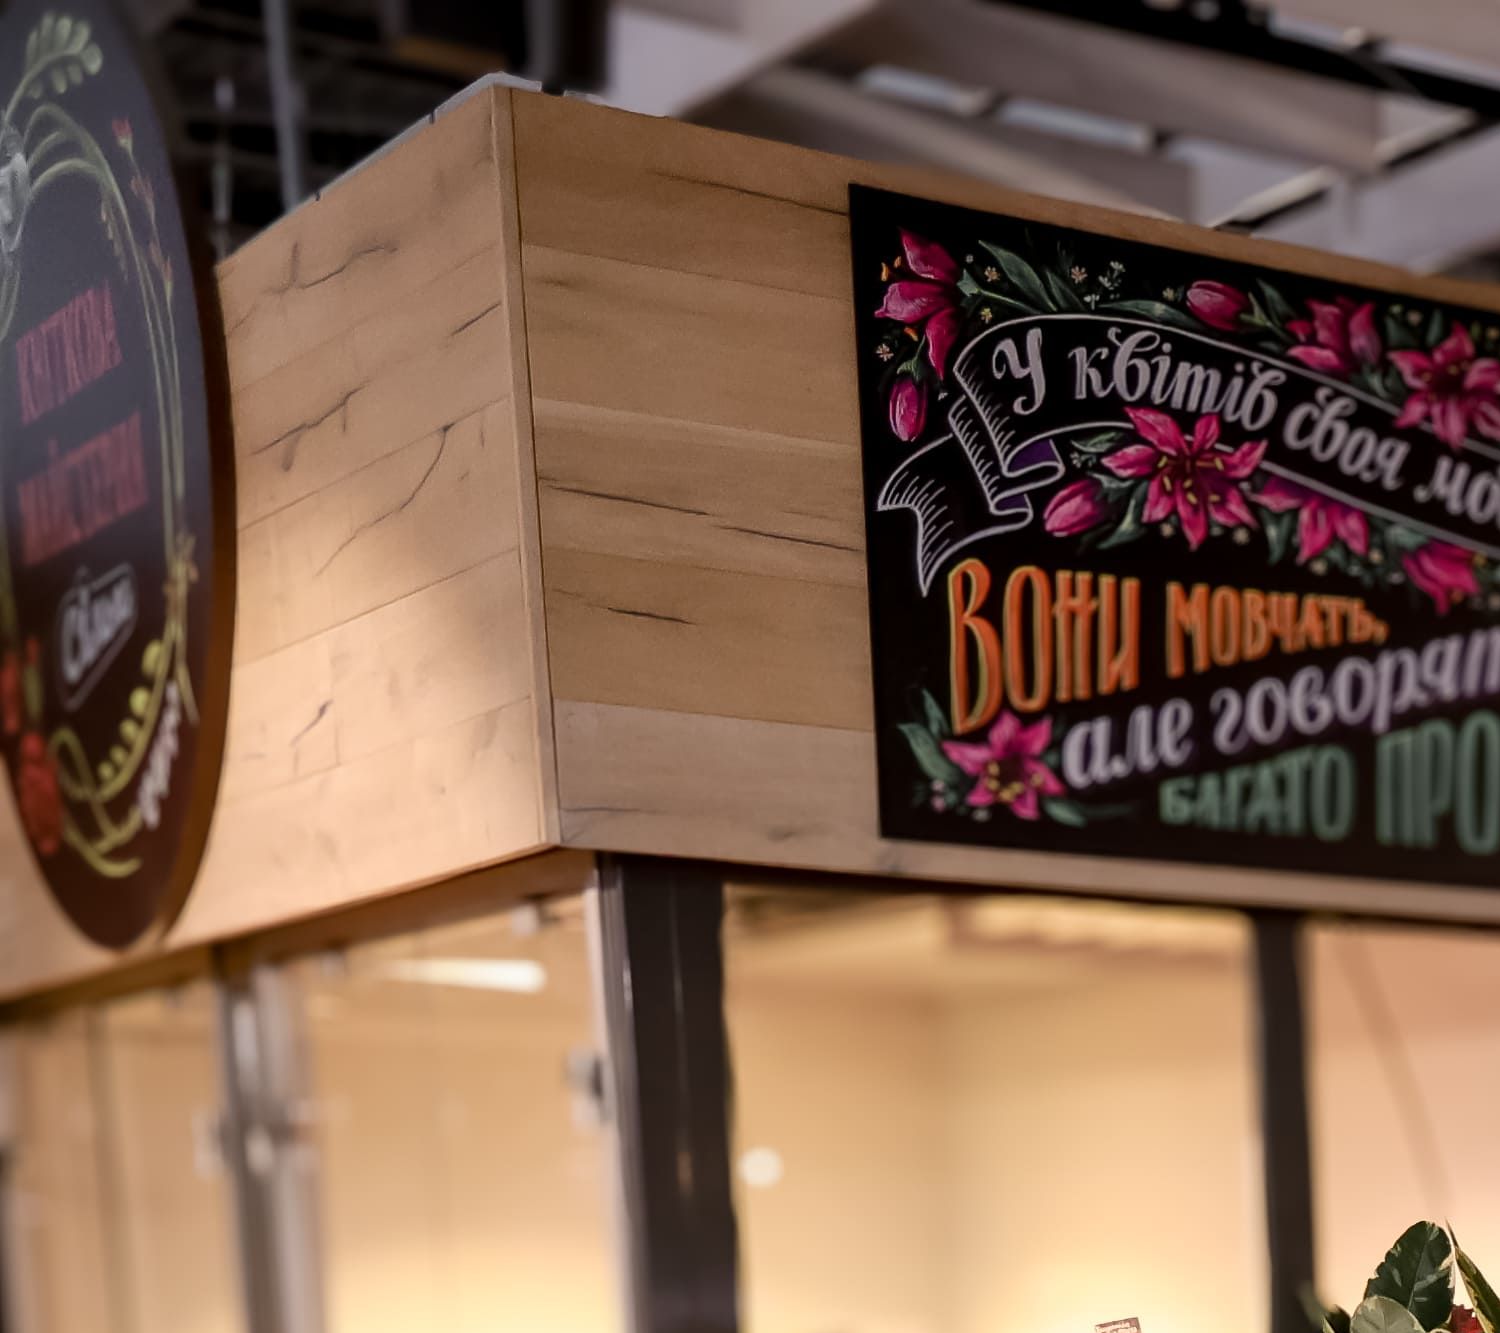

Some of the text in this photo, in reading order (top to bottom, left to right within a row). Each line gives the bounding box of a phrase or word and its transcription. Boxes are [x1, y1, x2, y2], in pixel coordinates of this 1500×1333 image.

[991, 327, 1046, 415] У
[1067, 326, 1286, 431] квітів
[1284, 386, 1410, 489] своя
[1061, 707, 1195, 790] але
[1160, 745, 1358, 843] БАГАТО
